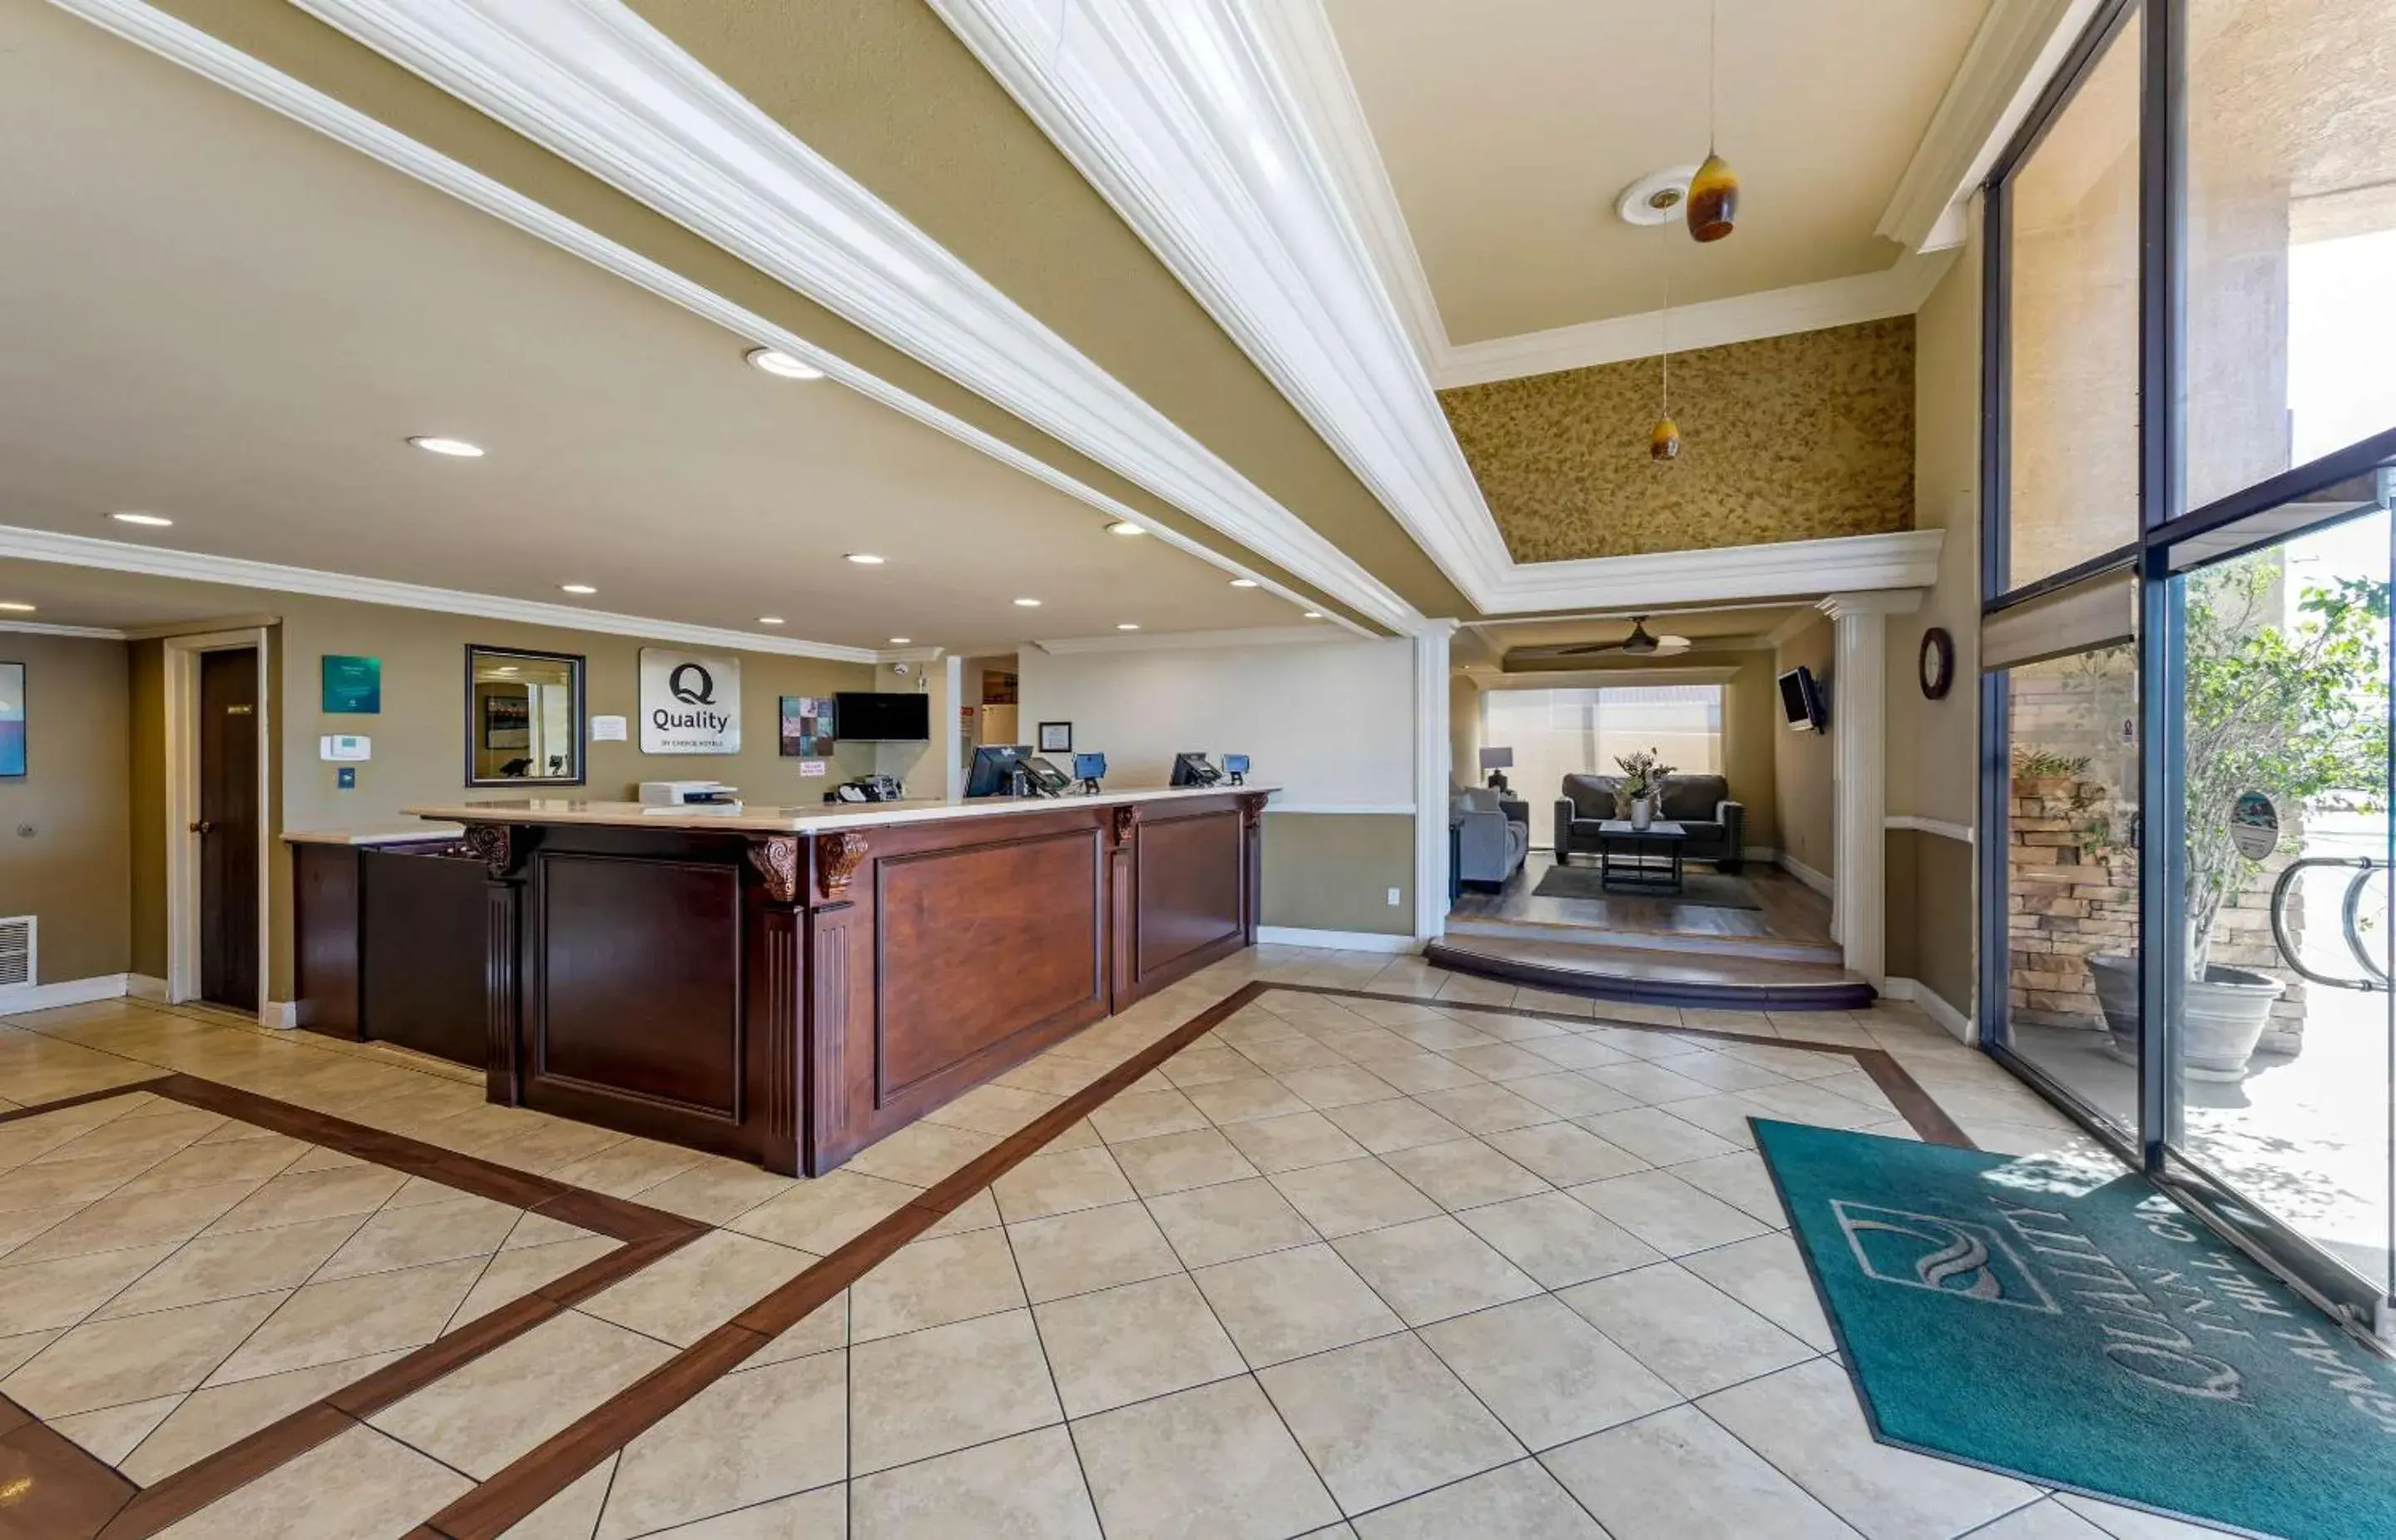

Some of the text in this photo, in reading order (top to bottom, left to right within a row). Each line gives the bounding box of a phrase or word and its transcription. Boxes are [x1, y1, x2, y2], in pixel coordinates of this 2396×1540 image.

[652, 709, 728, 734] Quality
[1988, 1196, 2254, 1407] QUALITY
[2136, 1265, 2256, 1340] INN
